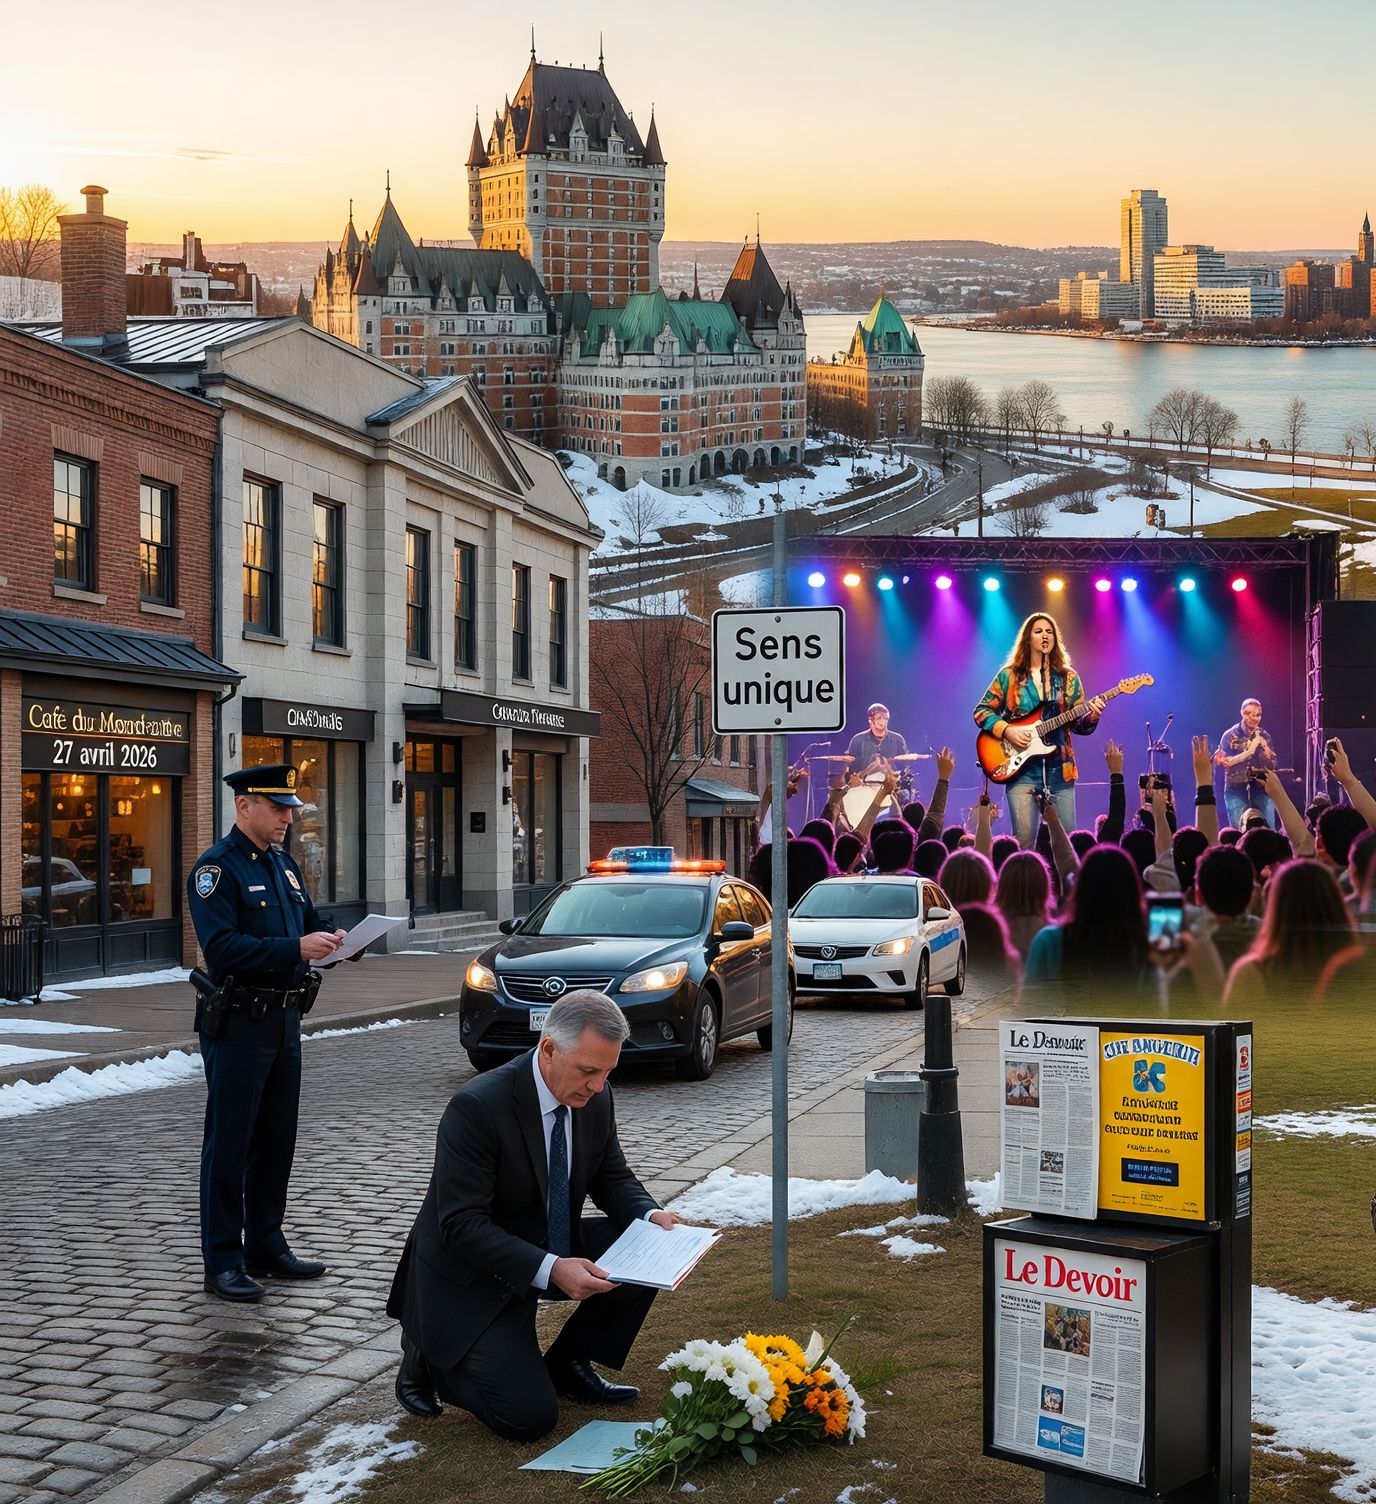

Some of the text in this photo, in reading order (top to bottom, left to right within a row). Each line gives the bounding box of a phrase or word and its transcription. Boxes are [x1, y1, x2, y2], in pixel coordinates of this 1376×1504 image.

[735, 626, 822, 661] Sens
[723, 671, 835, 713] unique
[29, 704, 67, 730] Café
[53, 739, 157, 768] 27 avril 2026
[1010, 1029, 1029, 1048] Le
[1004, 1248, 1137, 1302] Le Devoir
